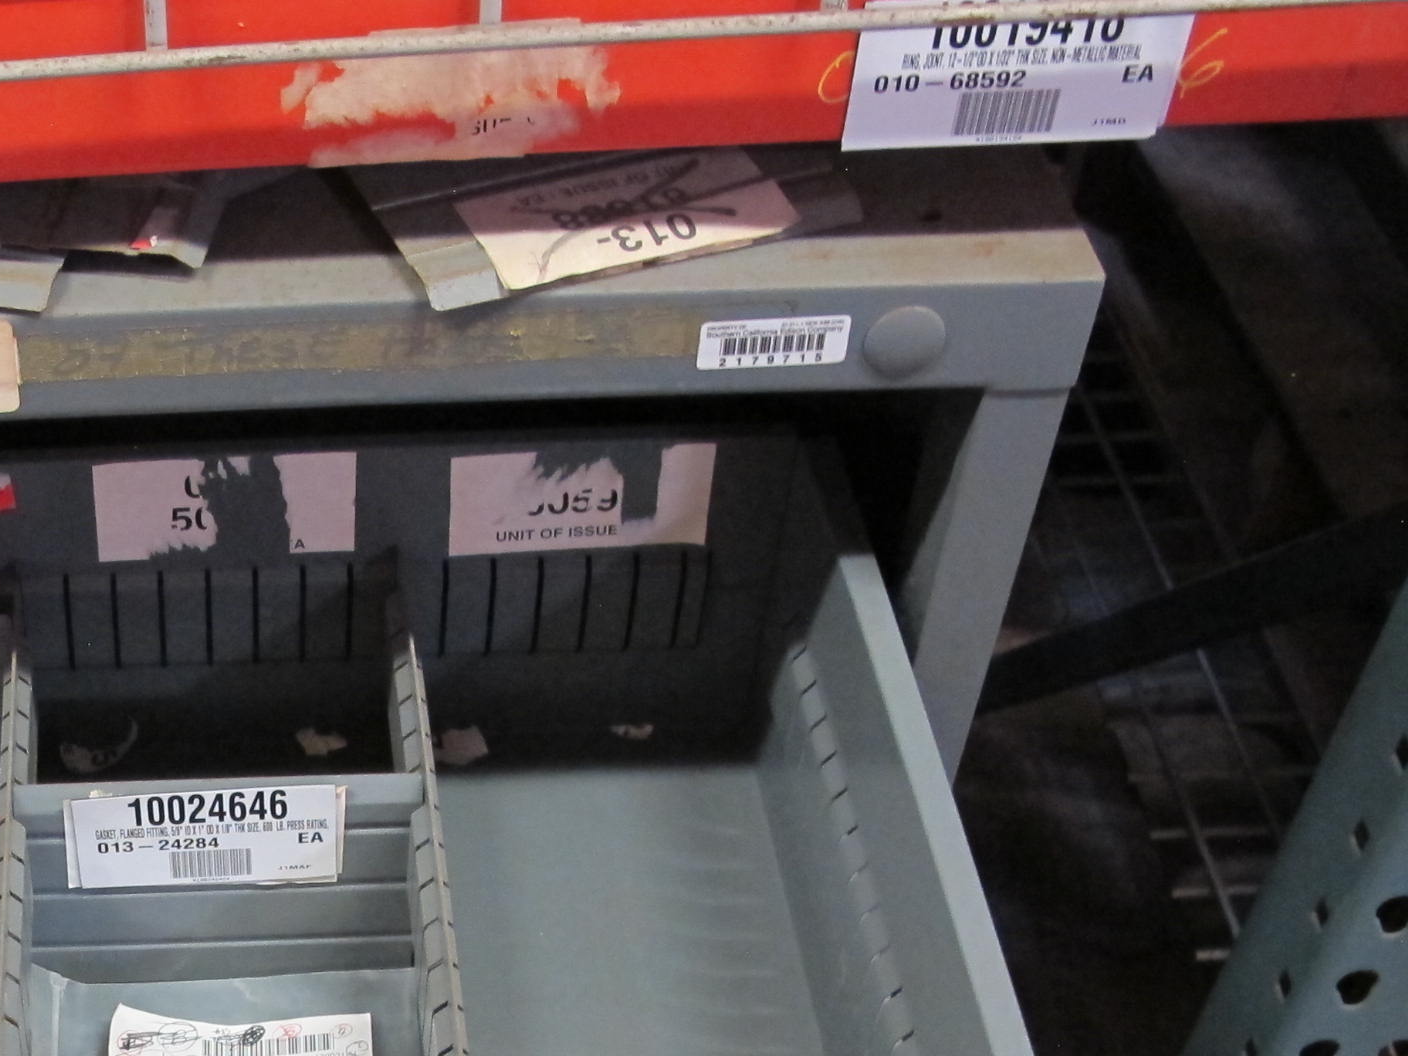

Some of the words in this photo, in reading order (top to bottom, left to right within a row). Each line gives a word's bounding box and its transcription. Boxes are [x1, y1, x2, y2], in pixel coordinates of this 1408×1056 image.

[1122, 64, 1154, 83] EA
[496, 530, 535, 542] UNIT
[540, 528, 563, 539] OF
[568, 525, 617, 538] ISSUE
[128, 789, 288, 826] 10024646
[298, 832, 324, 844] EA
